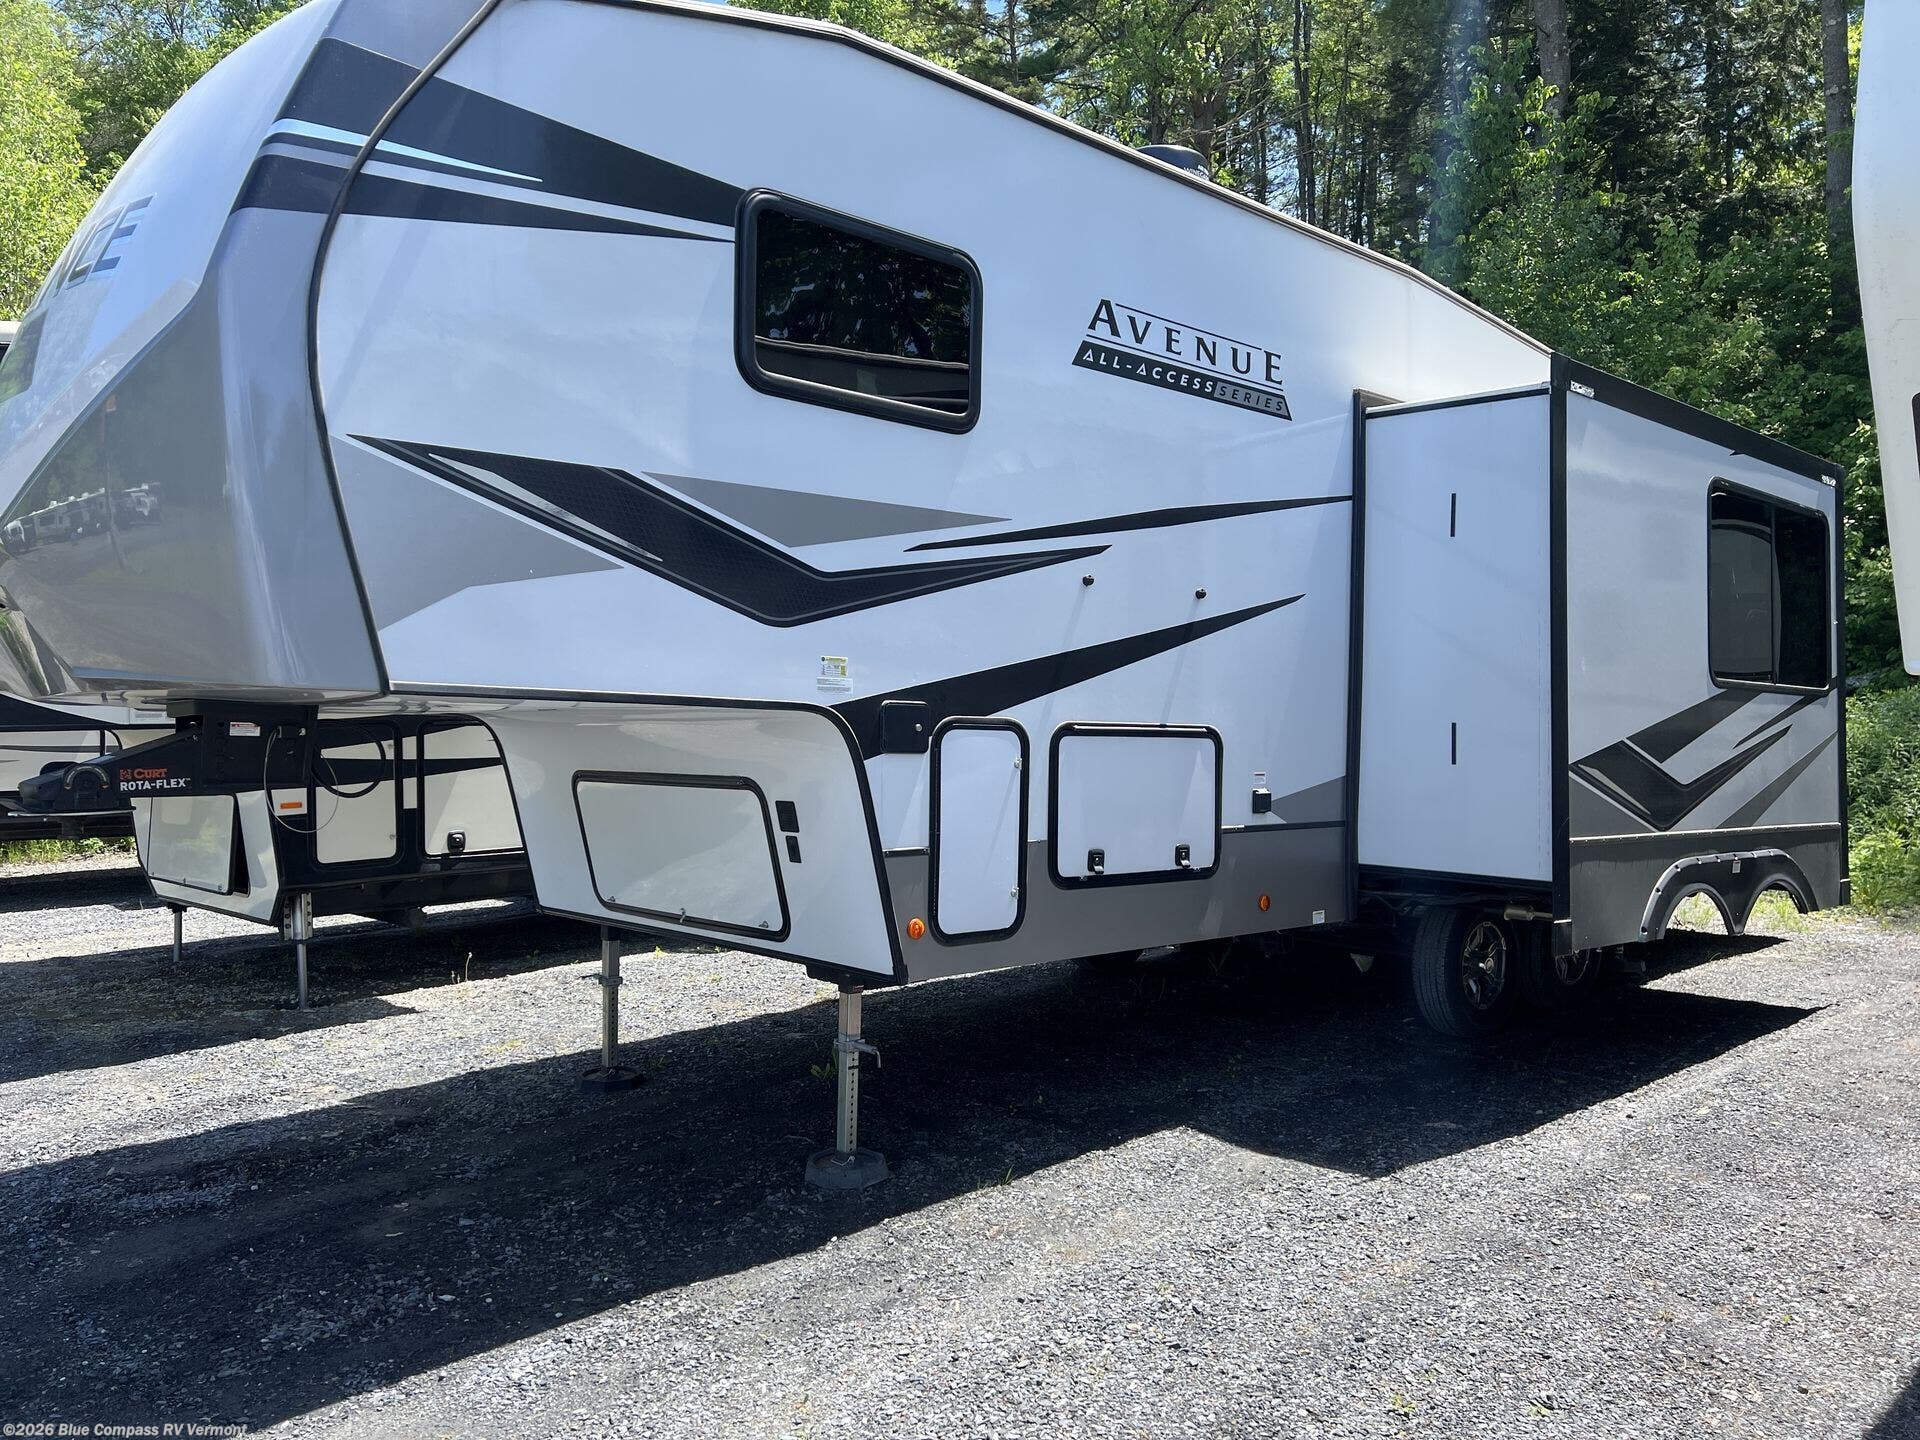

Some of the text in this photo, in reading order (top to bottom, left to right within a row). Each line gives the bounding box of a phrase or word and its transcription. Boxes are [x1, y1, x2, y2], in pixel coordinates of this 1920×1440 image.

[1082, 348, 1284, 412] ALL-ACCESS SERIES
[1087, 298, 1283, 386] AVENUE
